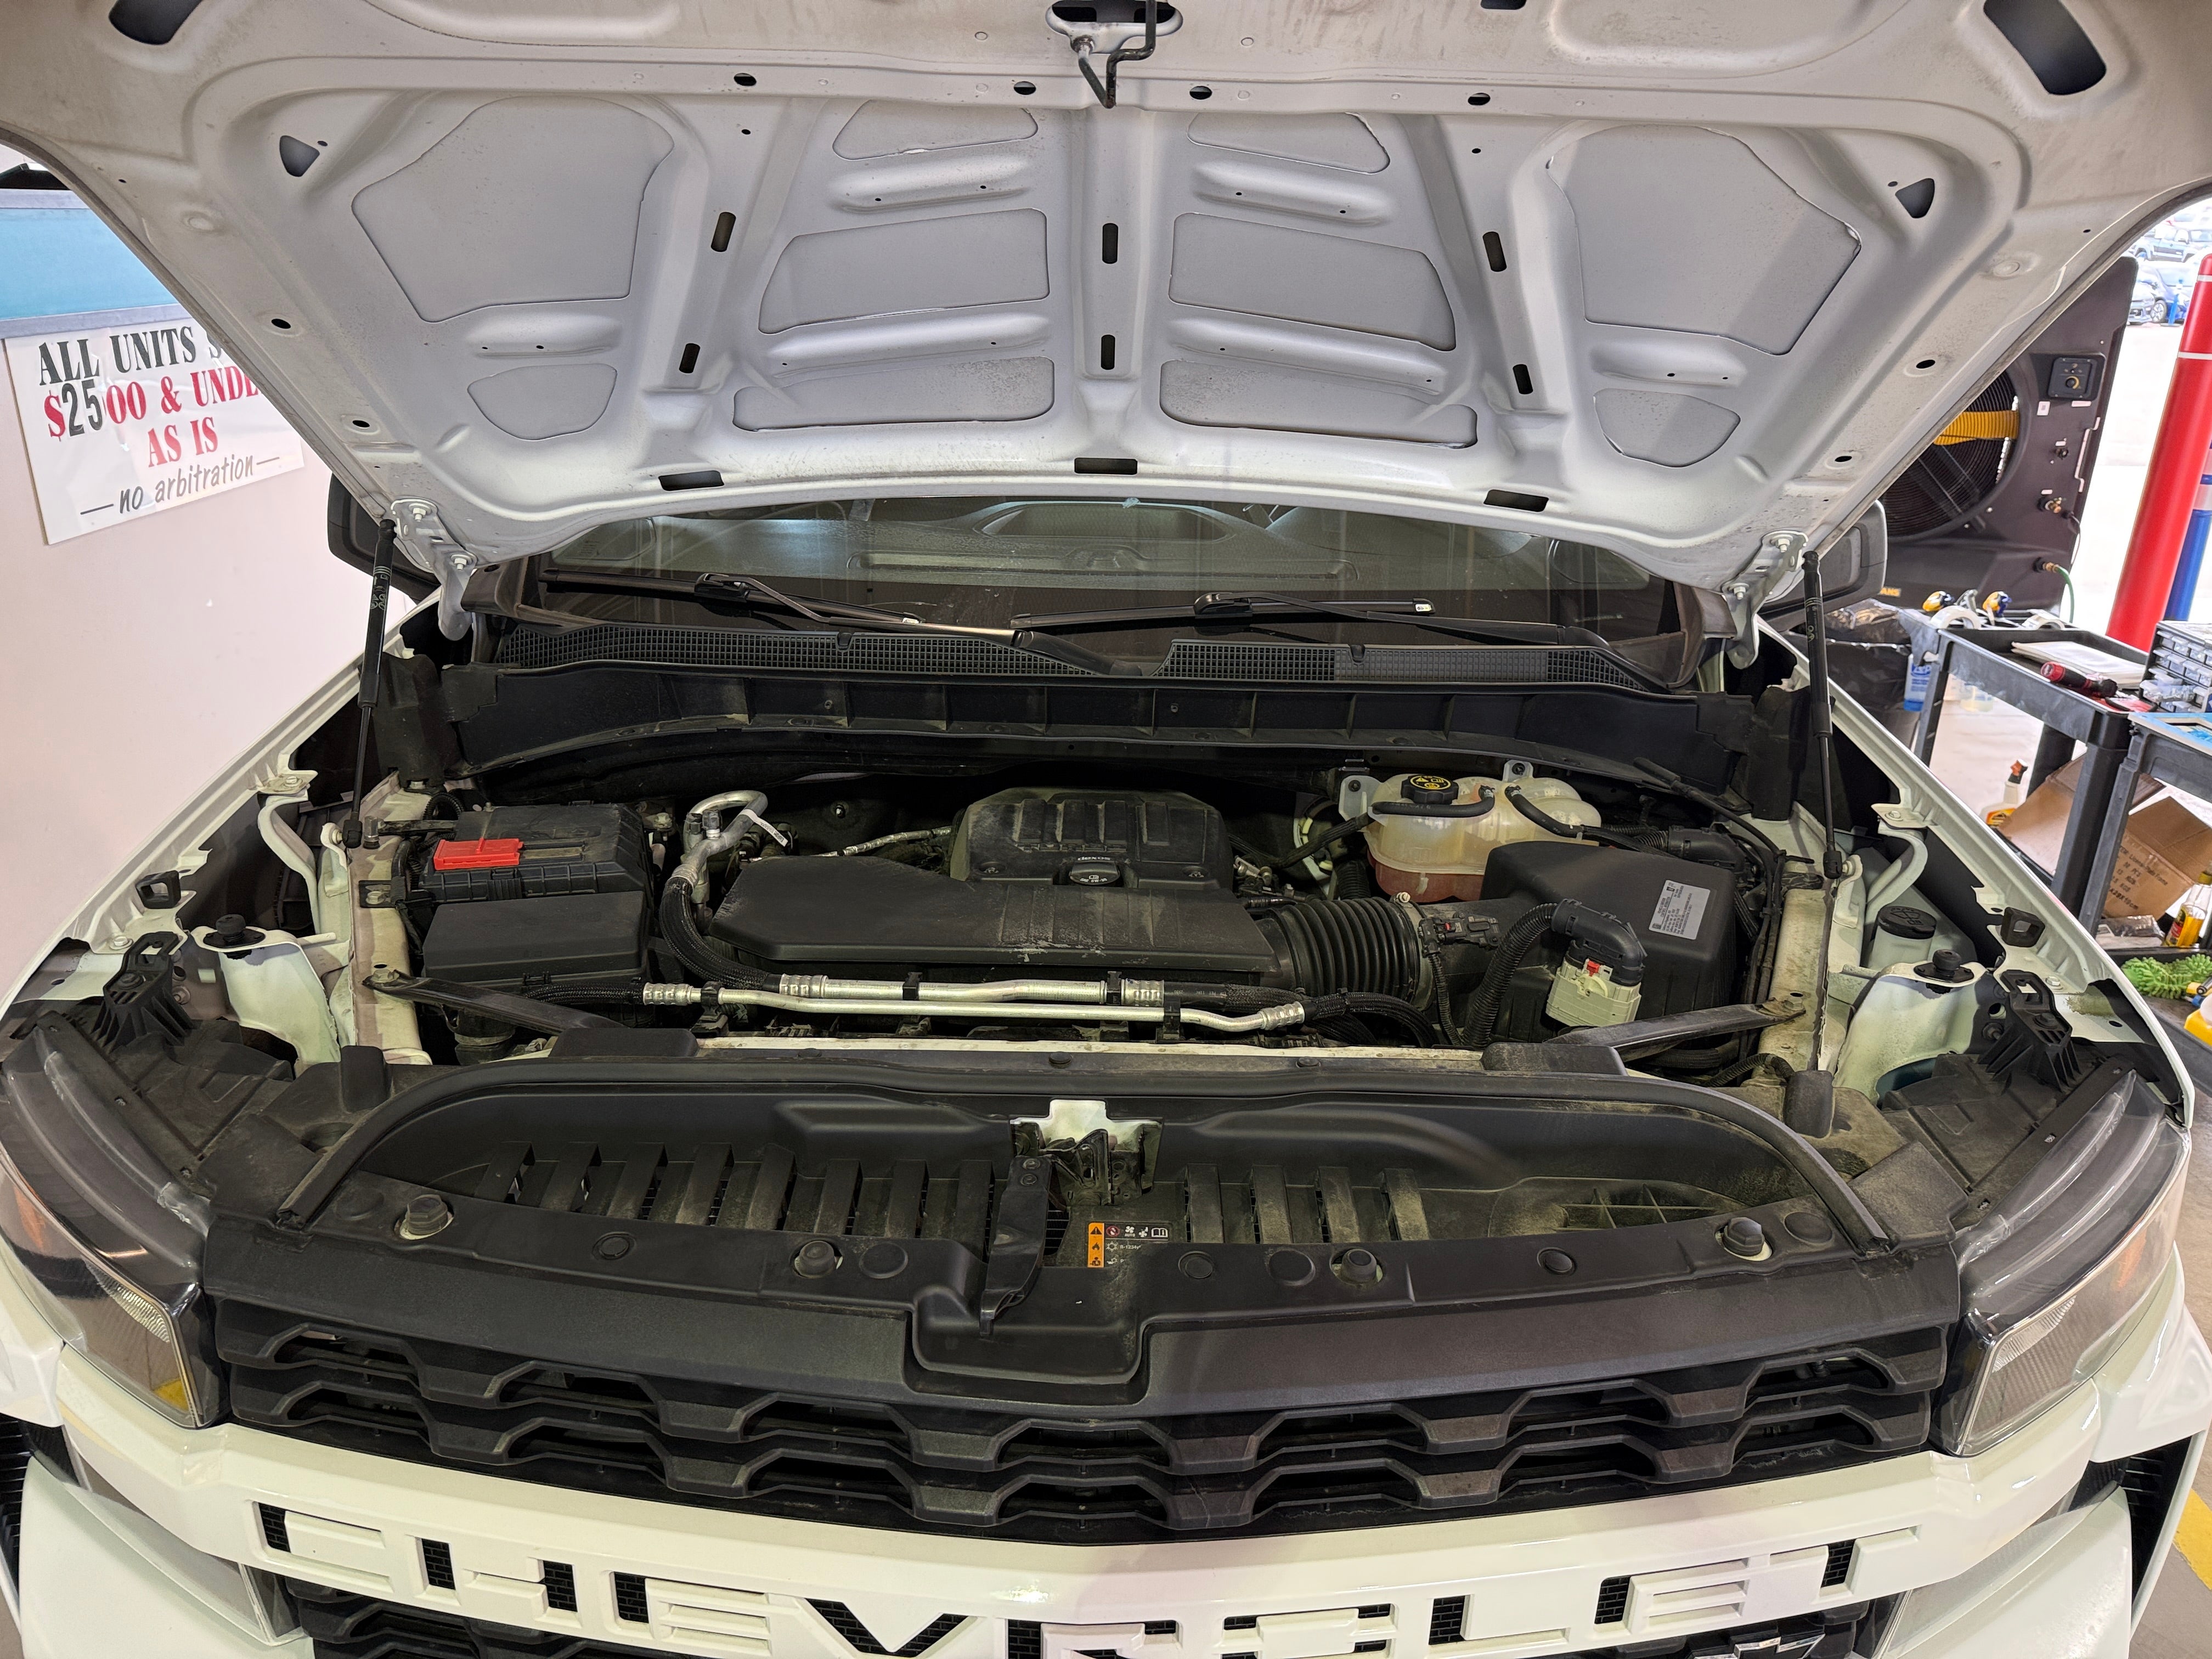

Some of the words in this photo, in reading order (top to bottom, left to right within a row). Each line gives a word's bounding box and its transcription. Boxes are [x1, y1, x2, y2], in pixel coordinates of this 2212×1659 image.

[39, 338, 100, 386] ALL
[109, 326, 196, 374] UNITS
[44, 379, 146, 441] $2500
[161, 376, 182, 414] &
[148, 425, 182, 467] AS
[190, 417, 218, 456] IS
[120, 486, 143, 514] no
[155, 455, 253, 501] arbitration
